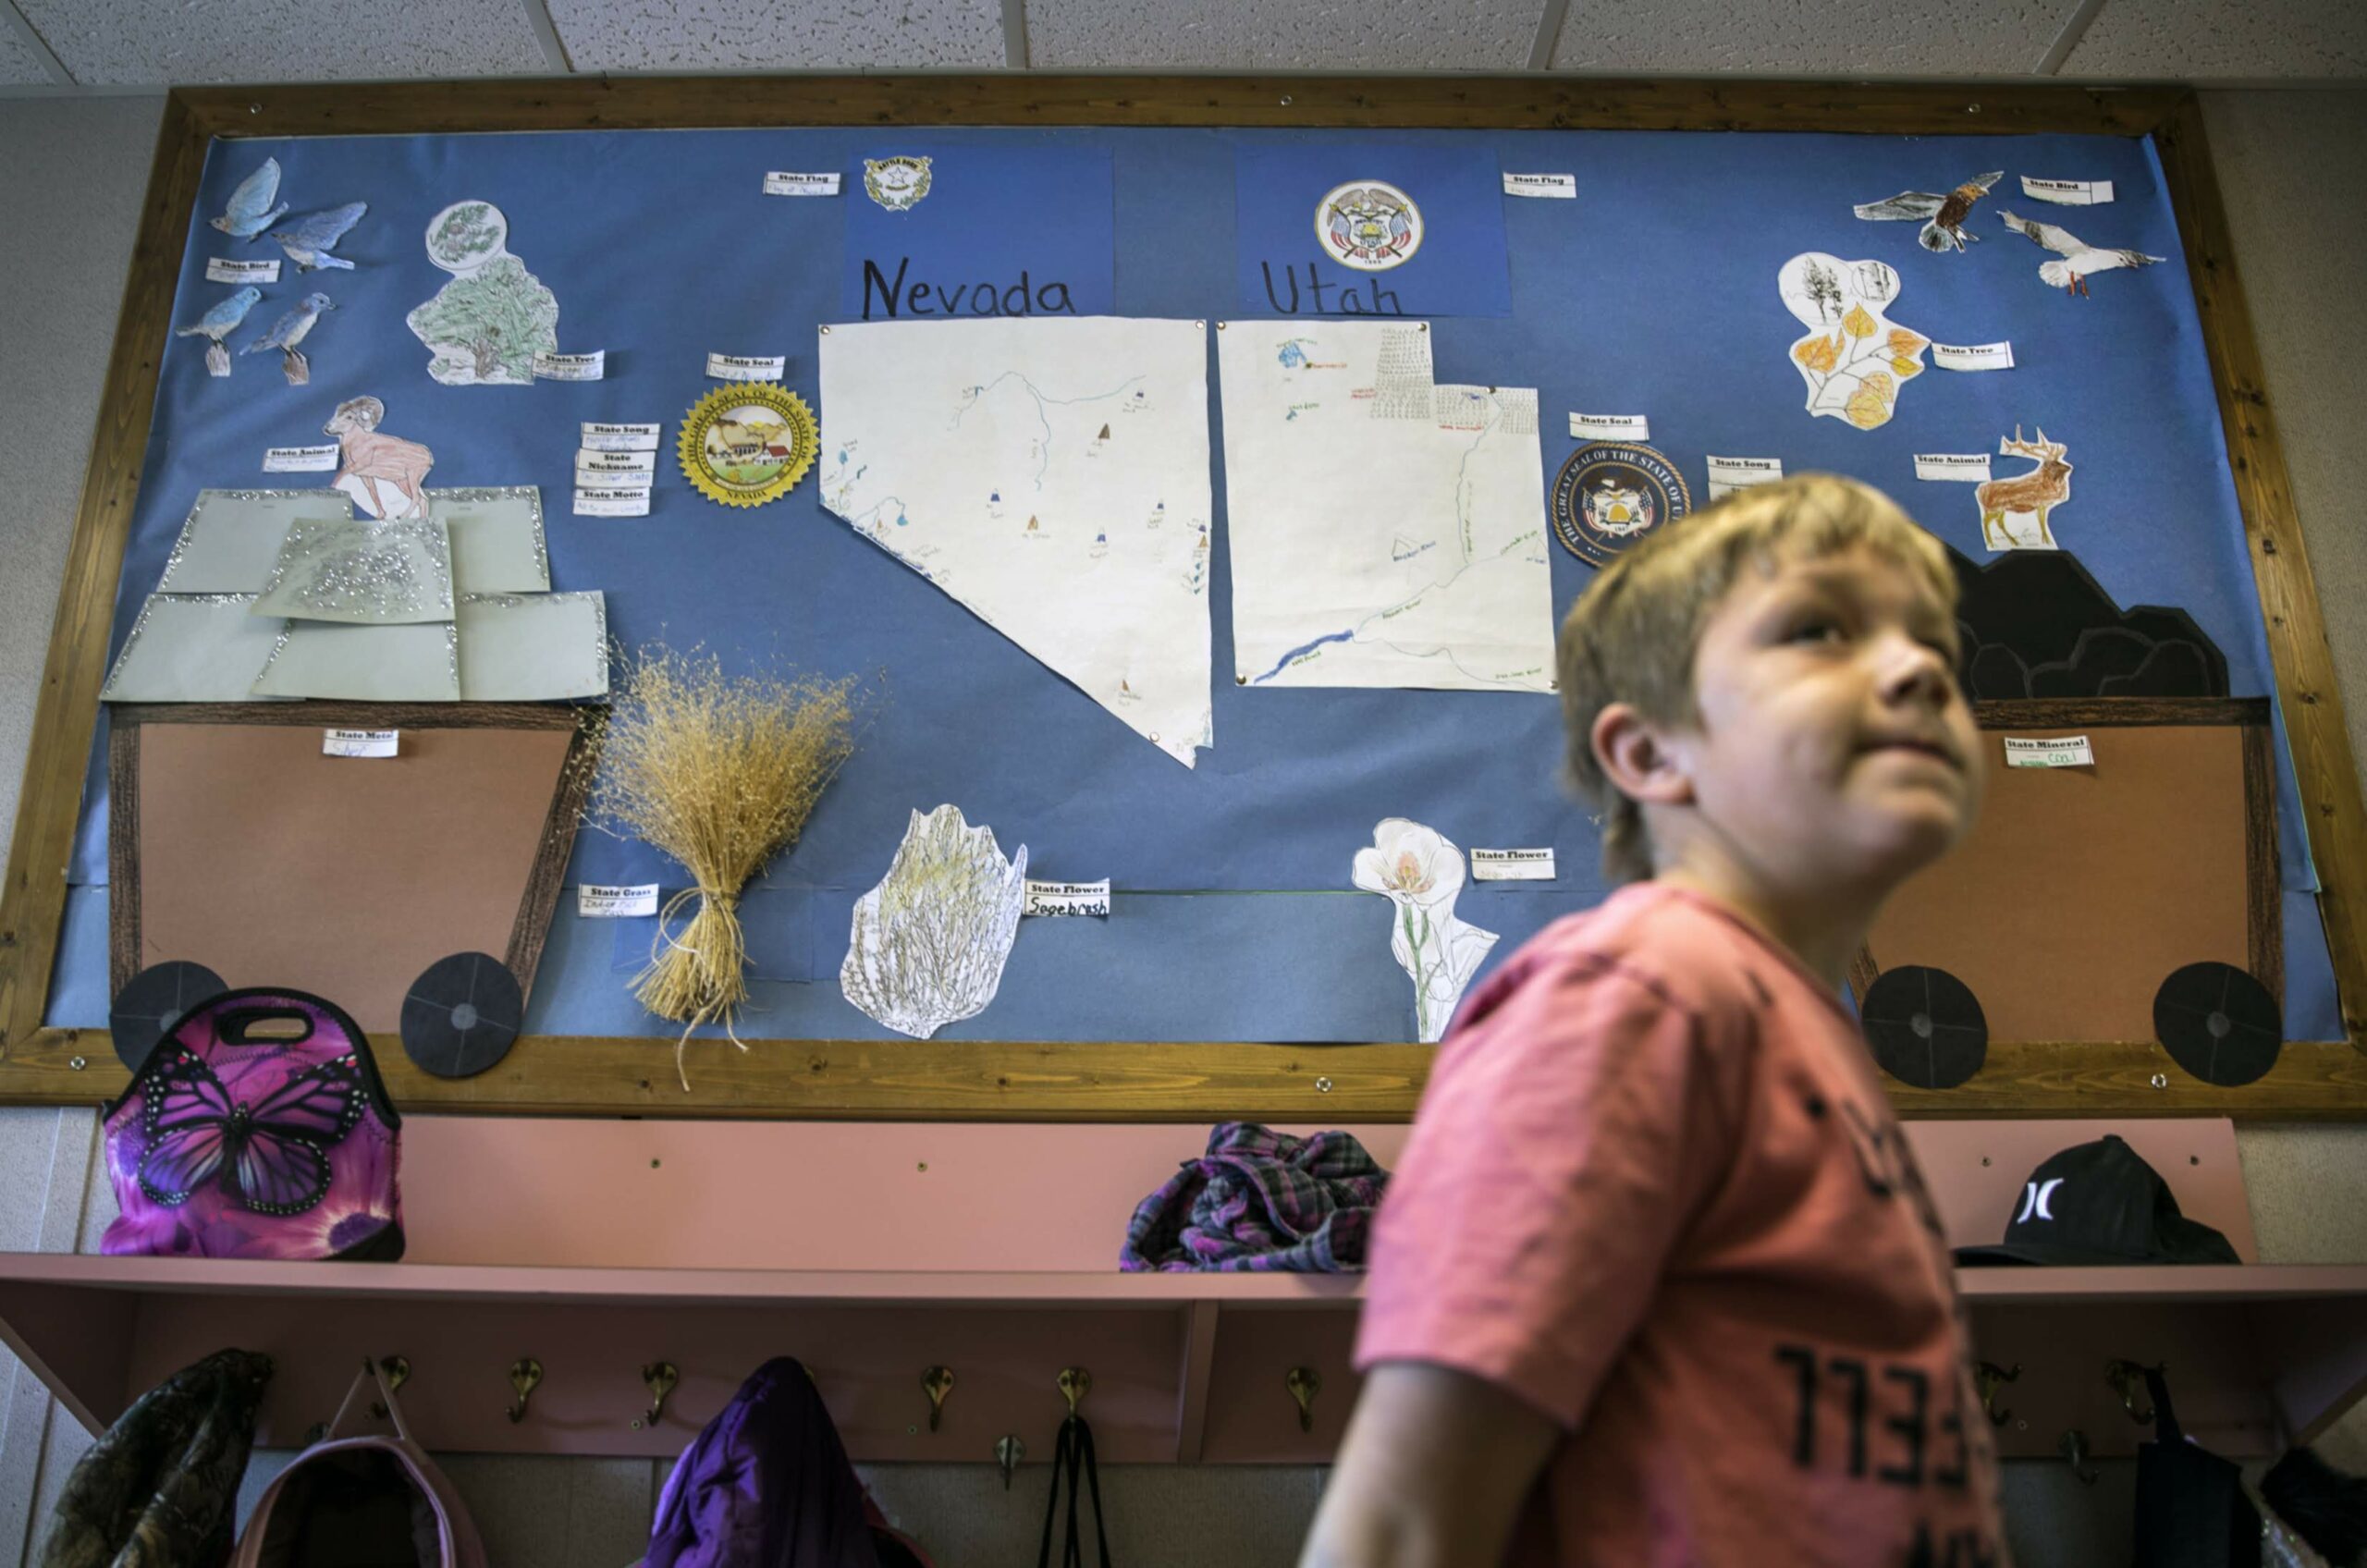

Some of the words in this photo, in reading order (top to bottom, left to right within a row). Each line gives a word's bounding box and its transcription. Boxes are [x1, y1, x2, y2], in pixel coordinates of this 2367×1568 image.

[2030, 179, 2054, 188] State
[221, 261, 247, 270] State
[862, 257, 1075, 320] Nevada
[1261, 261, 1403, 315] Utah
[546, 354, 571, 362] State
[724, 357, 750, 365] State
[1580, 416, 1607, 424] State
[623, 426, 650, 435] Song
[299, 447, 336, 456] Animal
[1593, 450, 1609, 460] OF
[1610, 450, 1638, 462] THE
[1570, 453, 1594, 474] SEAL
[1716, 459, 1741, 467] State
[1744, 460, 1770, 470] Song
[1637, 456, 1674, 487] STATE
[727, 490, 767, 500] NEVADA
[1558, 475, 1573, 516] GREAT
[1668, 485, 1683, 503] OF
[1561, 520, 1580, 545] THE
[2007, 740, 2034, 748] State
[2037, 739, 2084, 749] Mineral
[1476, 851, 1504, 859] State
[1507, 851, 1548, 859] Flower
[591, 888, 620, 897] State
[623, 888, 651, 897] Grass
[1032, 885, 1061, 893] State
[1063, 885, 1104, 893] Flower
